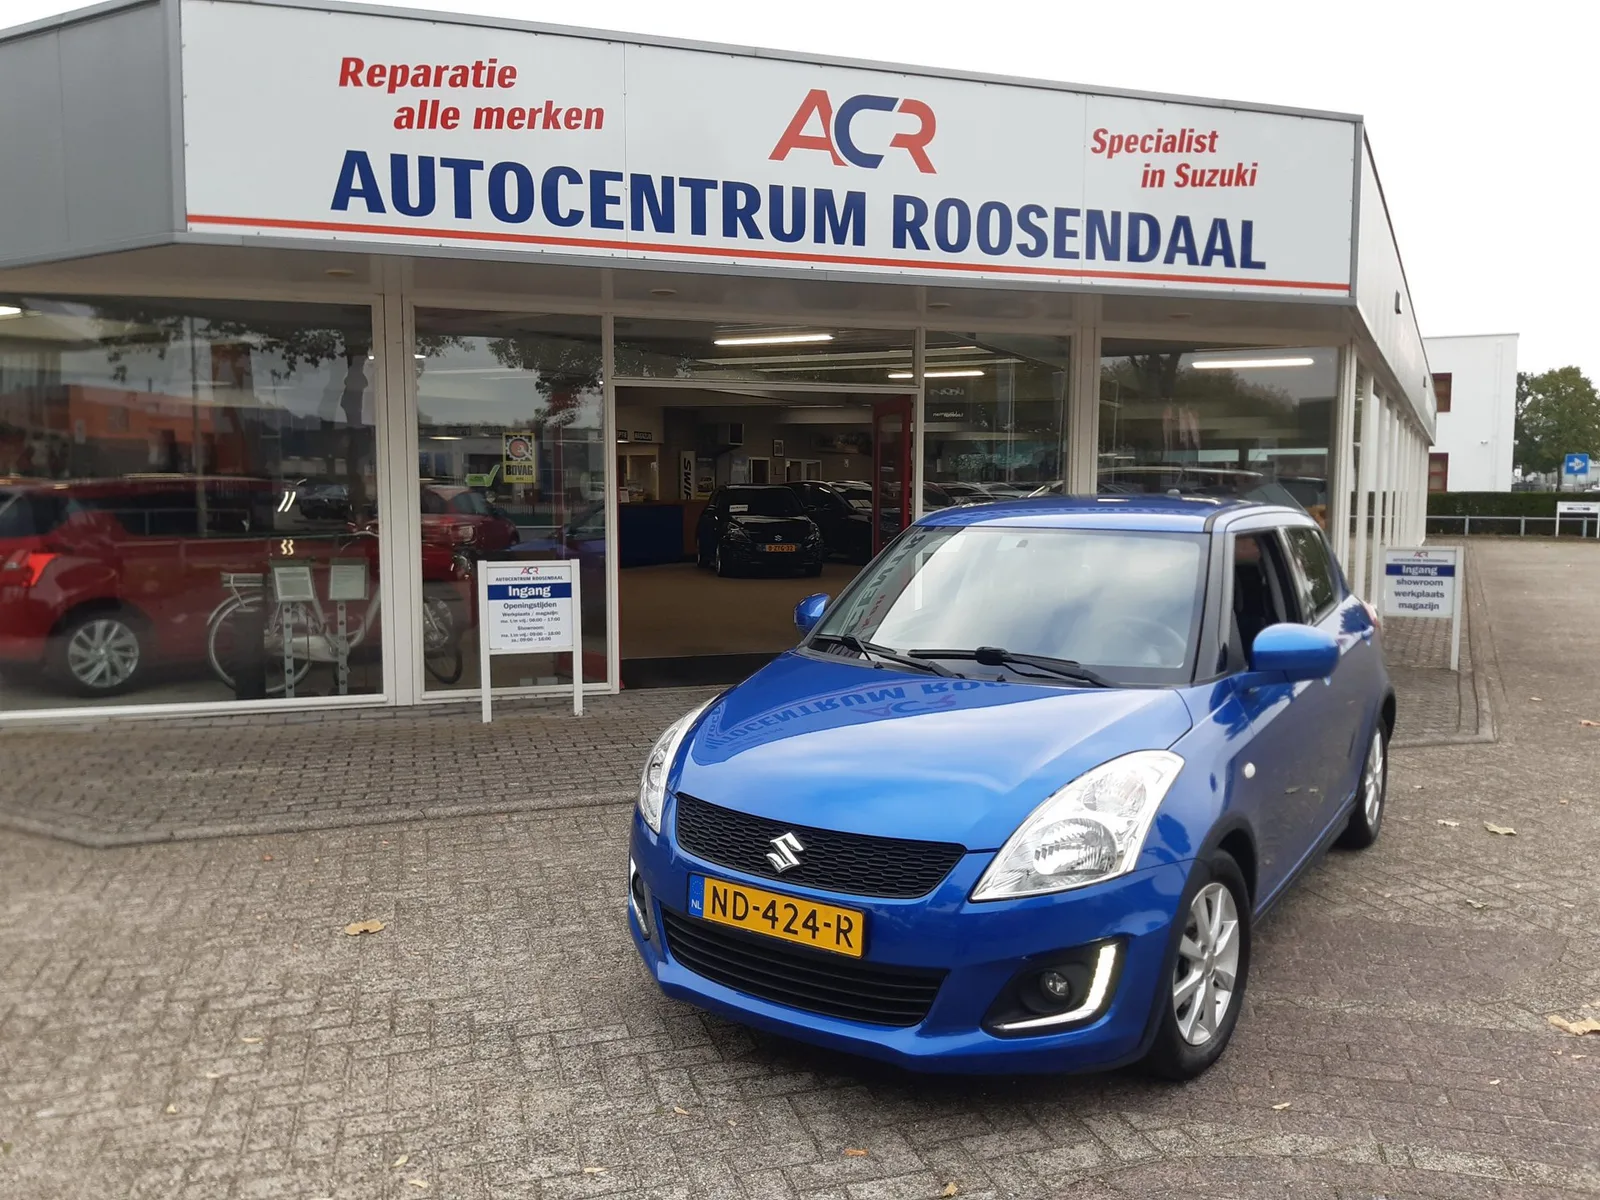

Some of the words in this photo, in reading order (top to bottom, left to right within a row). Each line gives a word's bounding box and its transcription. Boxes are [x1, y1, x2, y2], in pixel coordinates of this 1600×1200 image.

[339, 57, 517, 94] Reparatie
[393, 99, 460, 130] alle
[473, 101, 604, 130] merken
[768, 89, 937, 174] ACR
[1091, 128, 1218, 159] Specialist
[1141, 165, 1166, 188] in
[1174, 163, 1258, 187] Suzuki
[331, 149, 866, 247] AUTOCENTRUM
[892, 194, 1266, 270] ROOSENDAAL
[506, 464, 533, 476] BOVAG
[521, 566, 539, 575] ACR
[1402, 565, 1438, 576] Ingang
[1396, 578, 1444, 587] showroom
[508, 585, 551, 599] Ingang
[1394, 590, 1445, 599] werkplaats
[503, 601, 557, 611] Openingstijden
[1398, 602, 1440, 611] magazijn
[691, 899, 702, 910] NL
[711, 885, 854, 949] ND-424-R
